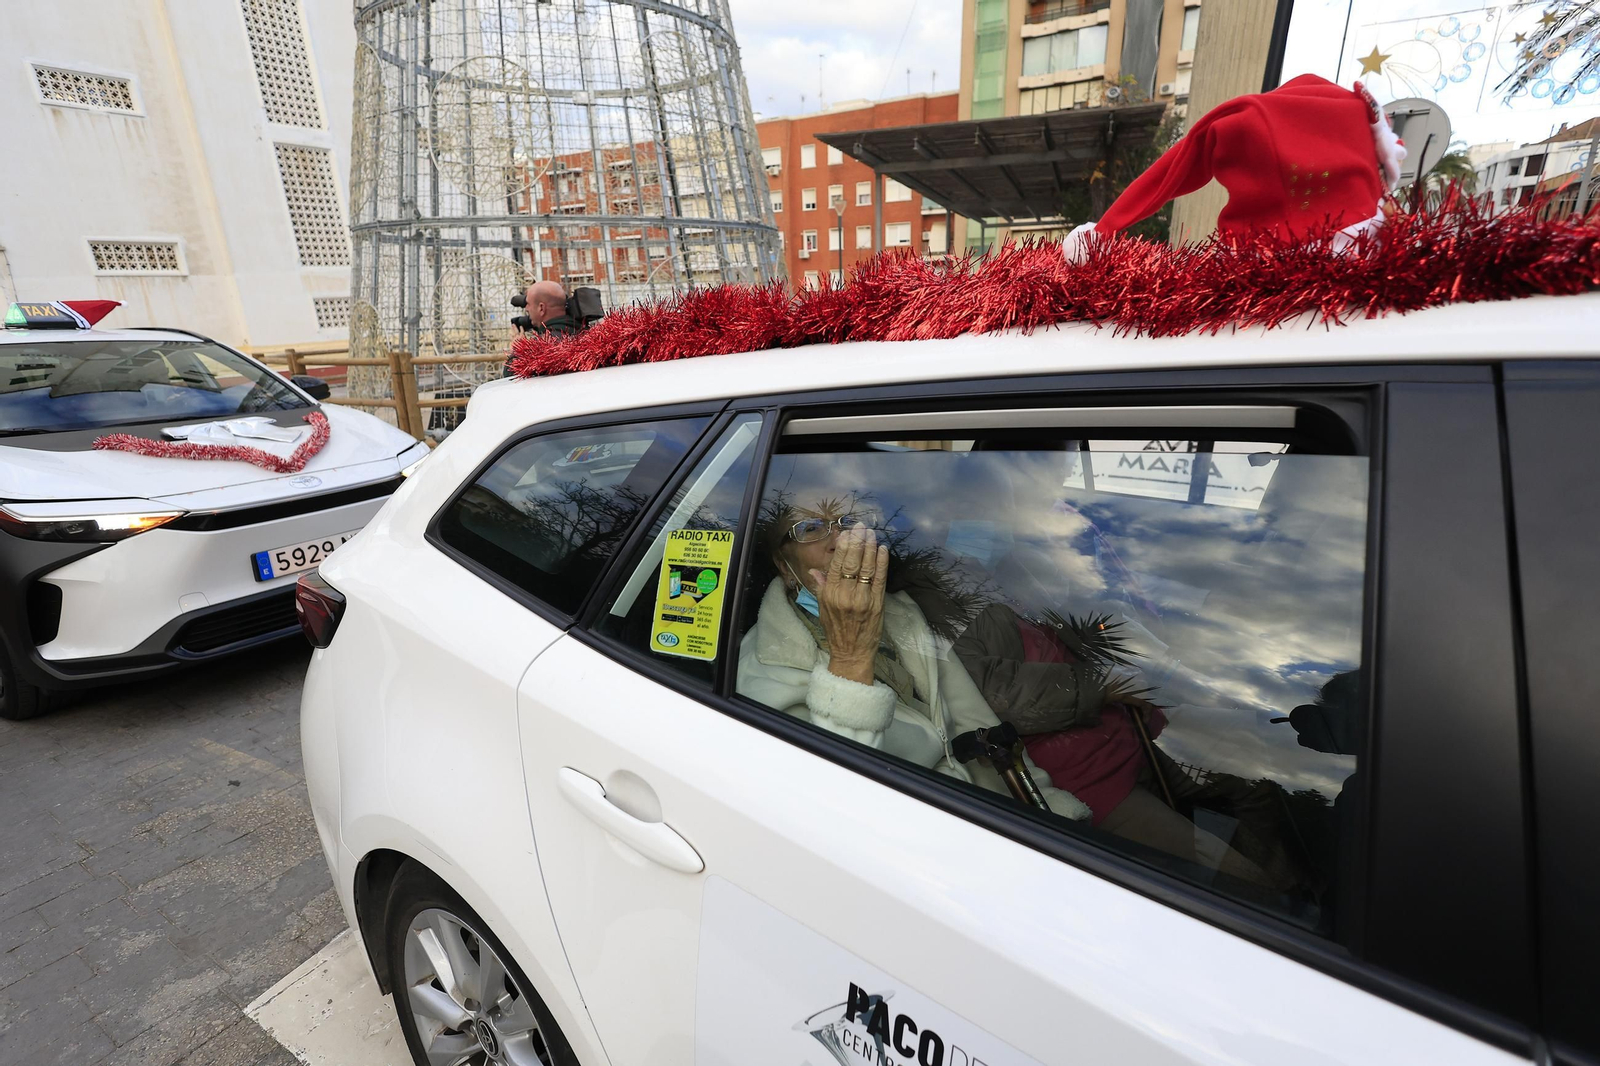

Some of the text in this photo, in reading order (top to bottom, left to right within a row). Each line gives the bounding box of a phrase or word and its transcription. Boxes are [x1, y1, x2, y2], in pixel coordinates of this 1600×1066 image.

[21, 305, 60, 316] TAXI
[670, 530, 731, 543] RADIO TAXI
[275, 541, 335, 571] 5929
[682, 584, 697, 592] TAXI
[846, 981, 945, 1066] PACO
[843, 1029, 902, 1066] CENTR
